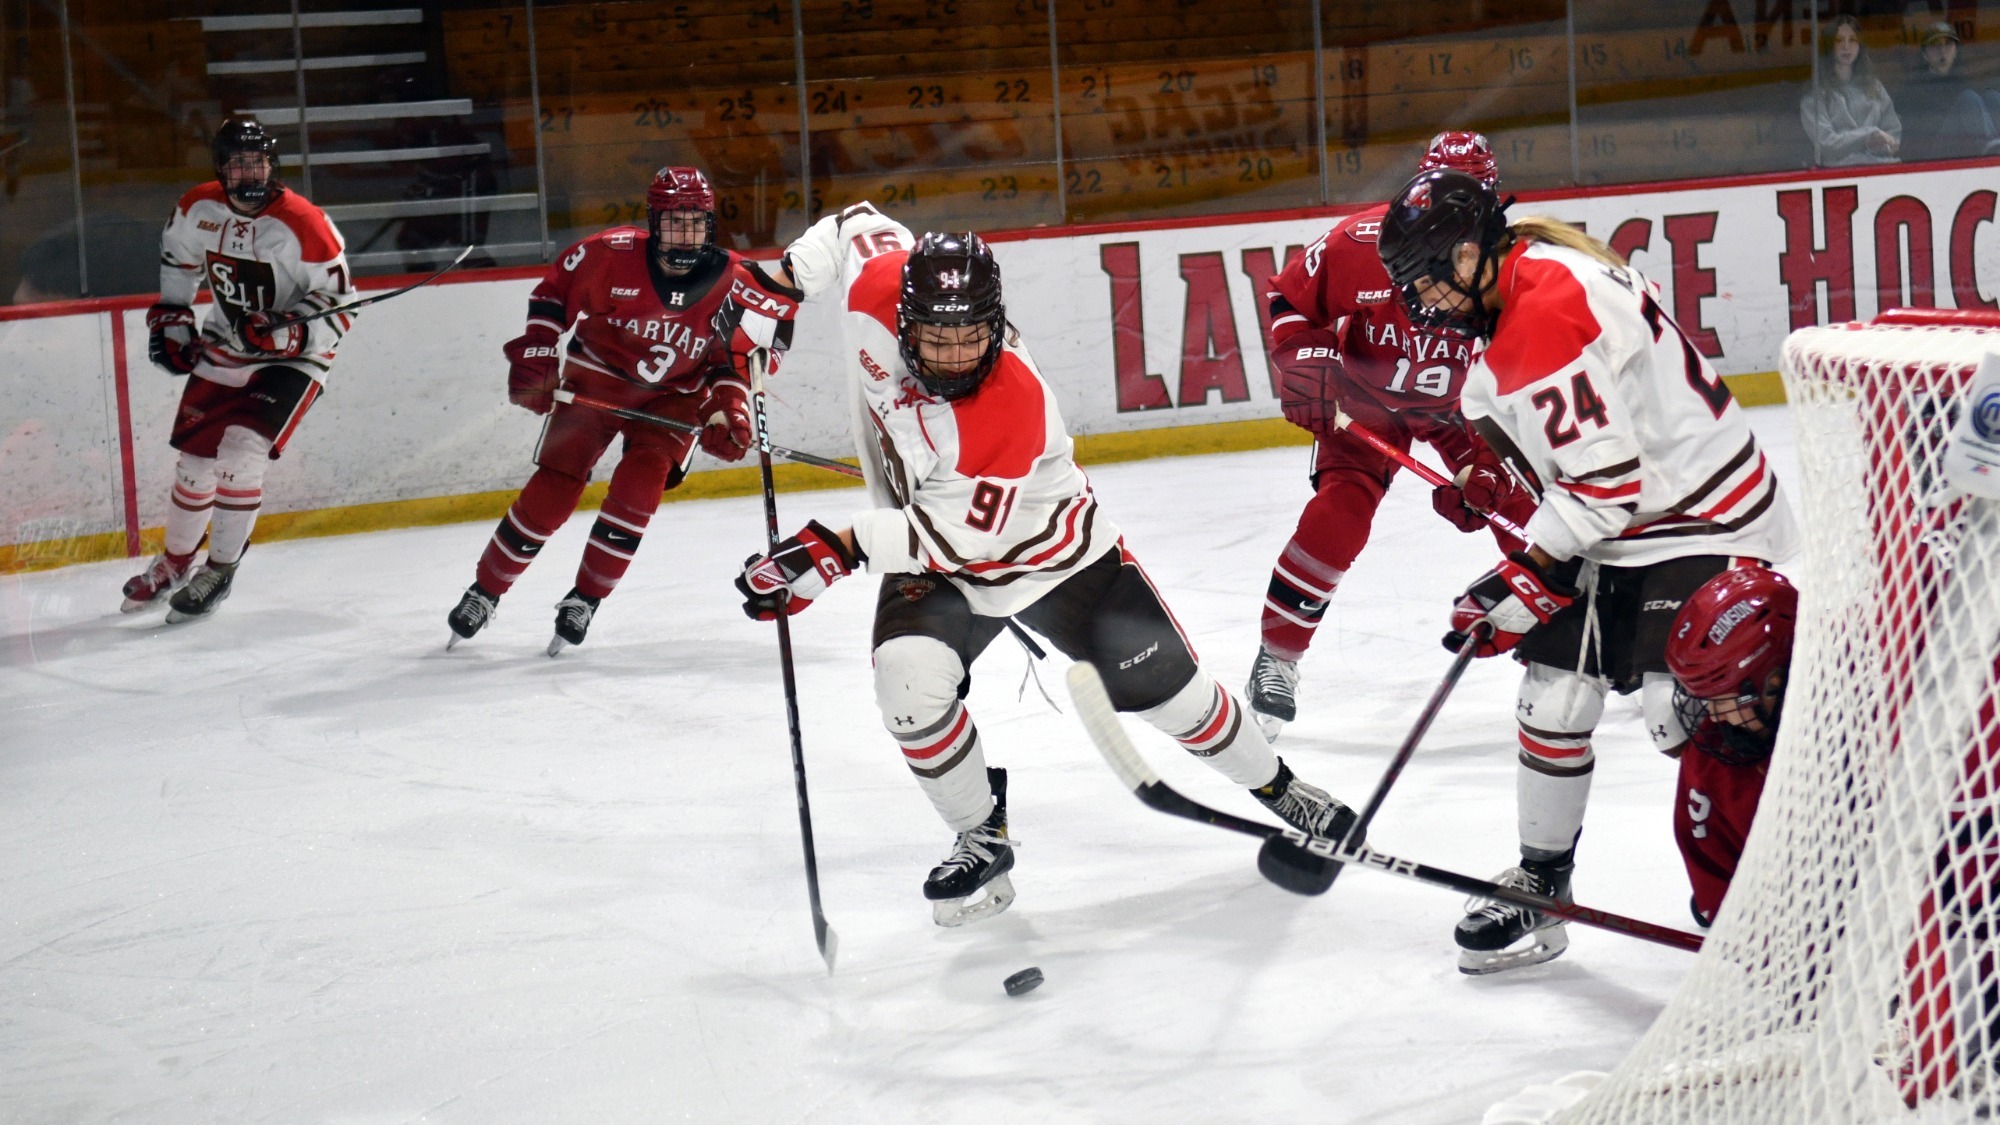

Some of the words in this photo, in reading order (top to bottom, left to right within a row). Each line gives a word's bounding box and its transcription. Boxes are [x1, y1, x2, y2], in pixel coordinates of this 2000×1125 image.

[1508, 48, 1534, 71] 16
[1581, 43, 1608, 66] 15
[1664, 37, 1687, 61] 14
[1429, 53, 1453, 75] 17
[994, 79, 1030, 103] 22
[1081, 74, 1112, 97] 21
[1158, 71, 1195, 93] 20
[718, 96, 757, 121] 25
[812, 90, 848, 114] 24
[908, 85, 944, 109] 23
[1239, 158, 1274, 182] 20
[1336, 152, 1362, 175] 19
[982, 176, 1018, 201] 23
[1067, 169, 1103, 195] 22
[1157, 165, 1188, 188] 21
[883, 183, 916, 208] 24
[719, 196, 738, 221] 6
[564, 244, 586, 272] 3
[611, 287, 641, 296] ECAC
[670, 292, 685, 306] H
[733, 279, 790, 317] CCM
[1357, 289, 1392, 299] ECAC
[933, 304, 969, 312] CCM
[607, 317, 714, 360] HARVAR
[636, 344, 677, 383] 3
[1296, 347, 1345, 367] BAU
[1386, 356, 1451, 397] 19
[1531, 370, 1610, 450] 24
[756, 395, 770, 454] CCM
[965, 480, 1018, 536] 91
[757, 574, 778, 586] CCM
[1643, 600, 1683, 612] CCM
[1678, 622, 1691, 639] 2
[1708, 600, 1756, 645] CRIMSON
[1118, 641, 1158, 670] CCM
